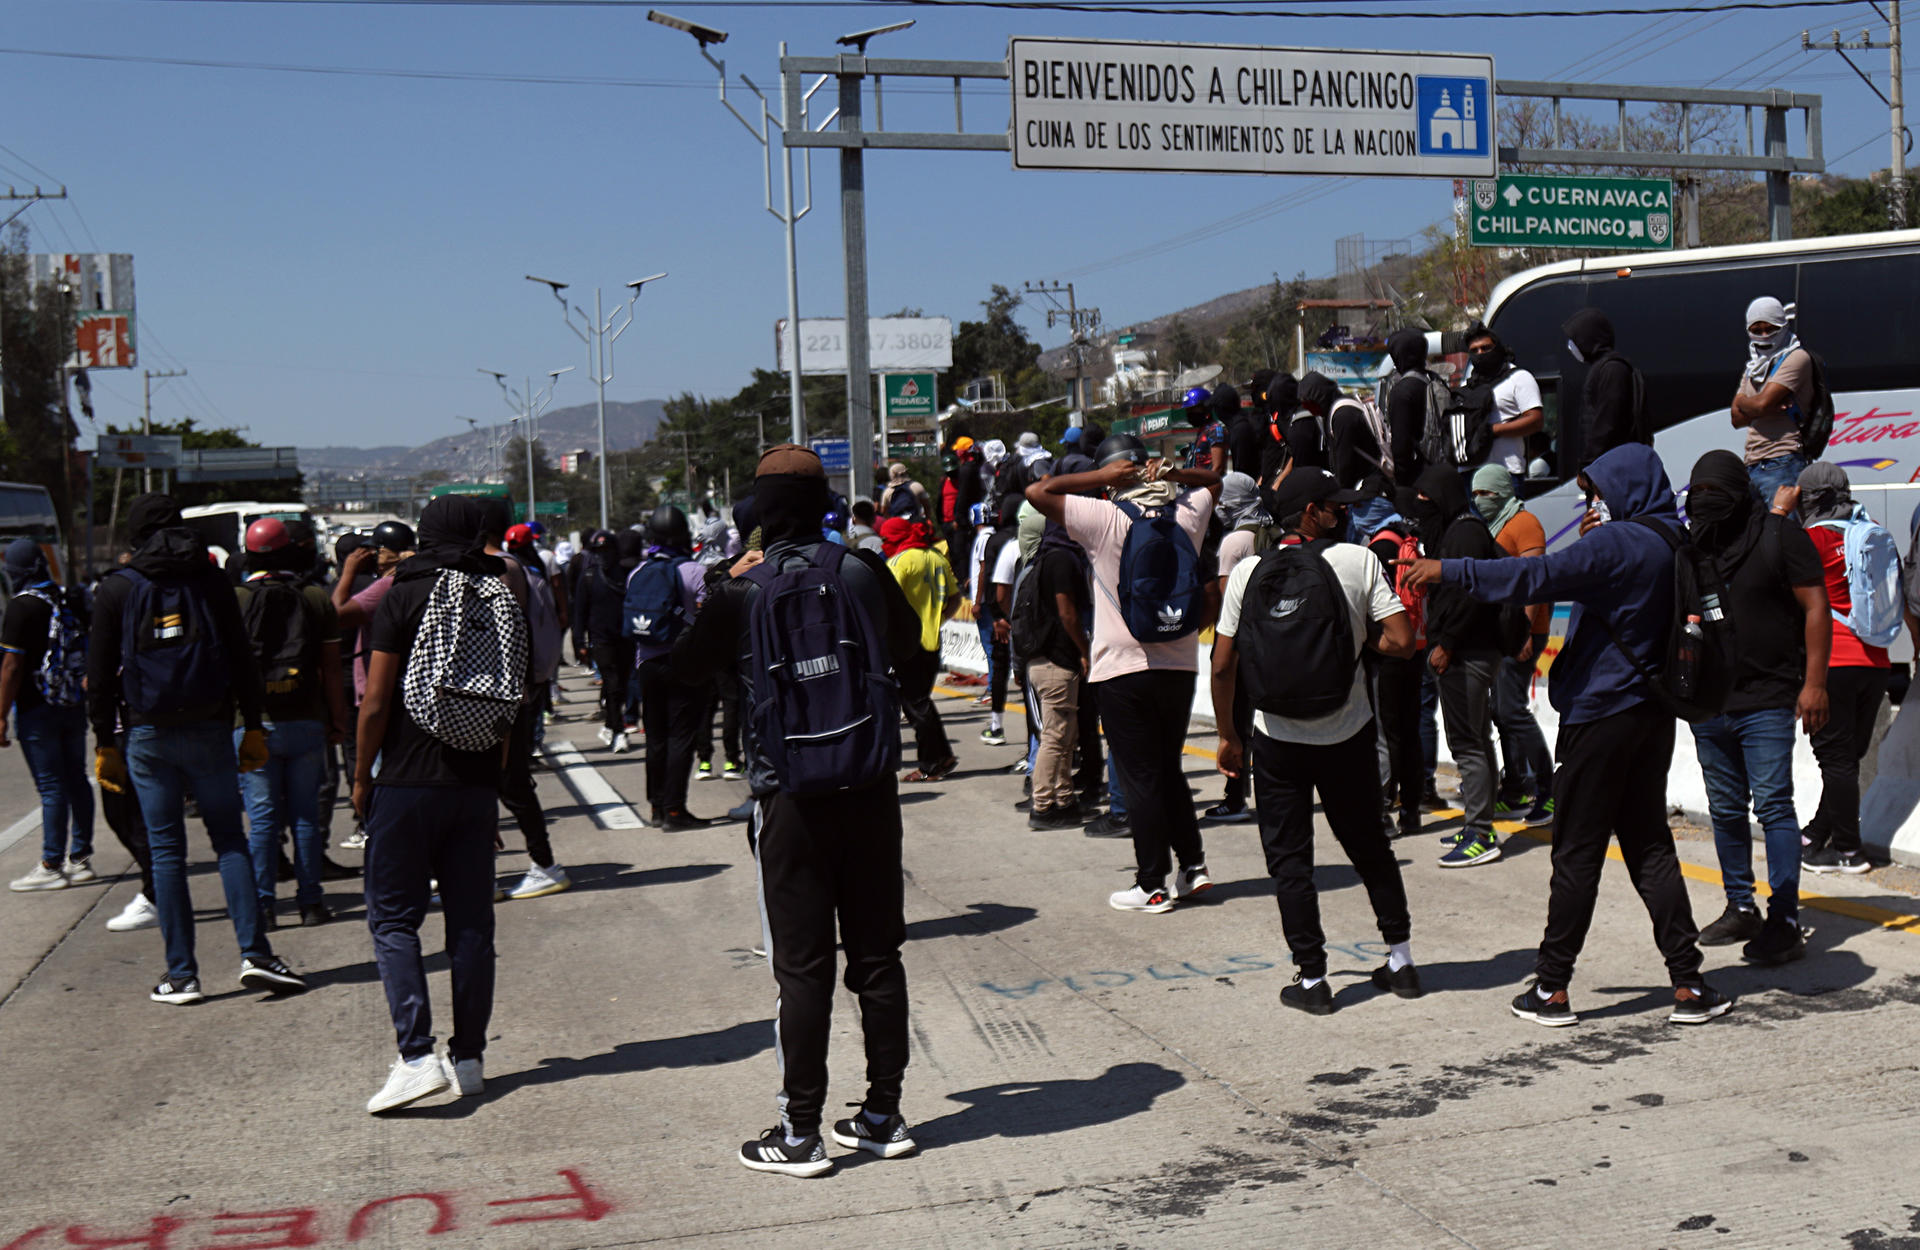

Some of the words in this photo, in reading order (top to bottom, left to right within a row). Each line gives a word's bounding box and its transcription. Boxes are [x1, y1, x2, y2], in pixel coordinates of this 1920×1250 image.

[1024, 59, 1196, 104] BIENVENIDOS
[1208, 66, 1226, 105] A
[1237, 67, 1415, 111] CHILPANCINGO
[1026, 119, 1076, 149] CUNA
[1085, 121, 1108, 150] DE
[1117, 122, 1152, 151] LOS
[1161, 124, 1285, 155] SENTIMIENTOS
[1293, 127, 1315, 155] DE
[1322, 128, 1346, 155] LA
[1354, 129, 1417, 157] NACION
[1478, 192, 1492, 205] 95
[1528, 187, 1670, 208] CUERNAVACA
[1477, 216, 1626, 237] CHILPANCINGO
[1651, 225, 1666, 238] 95
[890, 396, 931, 406] PEMEX
[792, 654, 840, 678] PUMA
[0, 1168, 614, 1250] FUER
